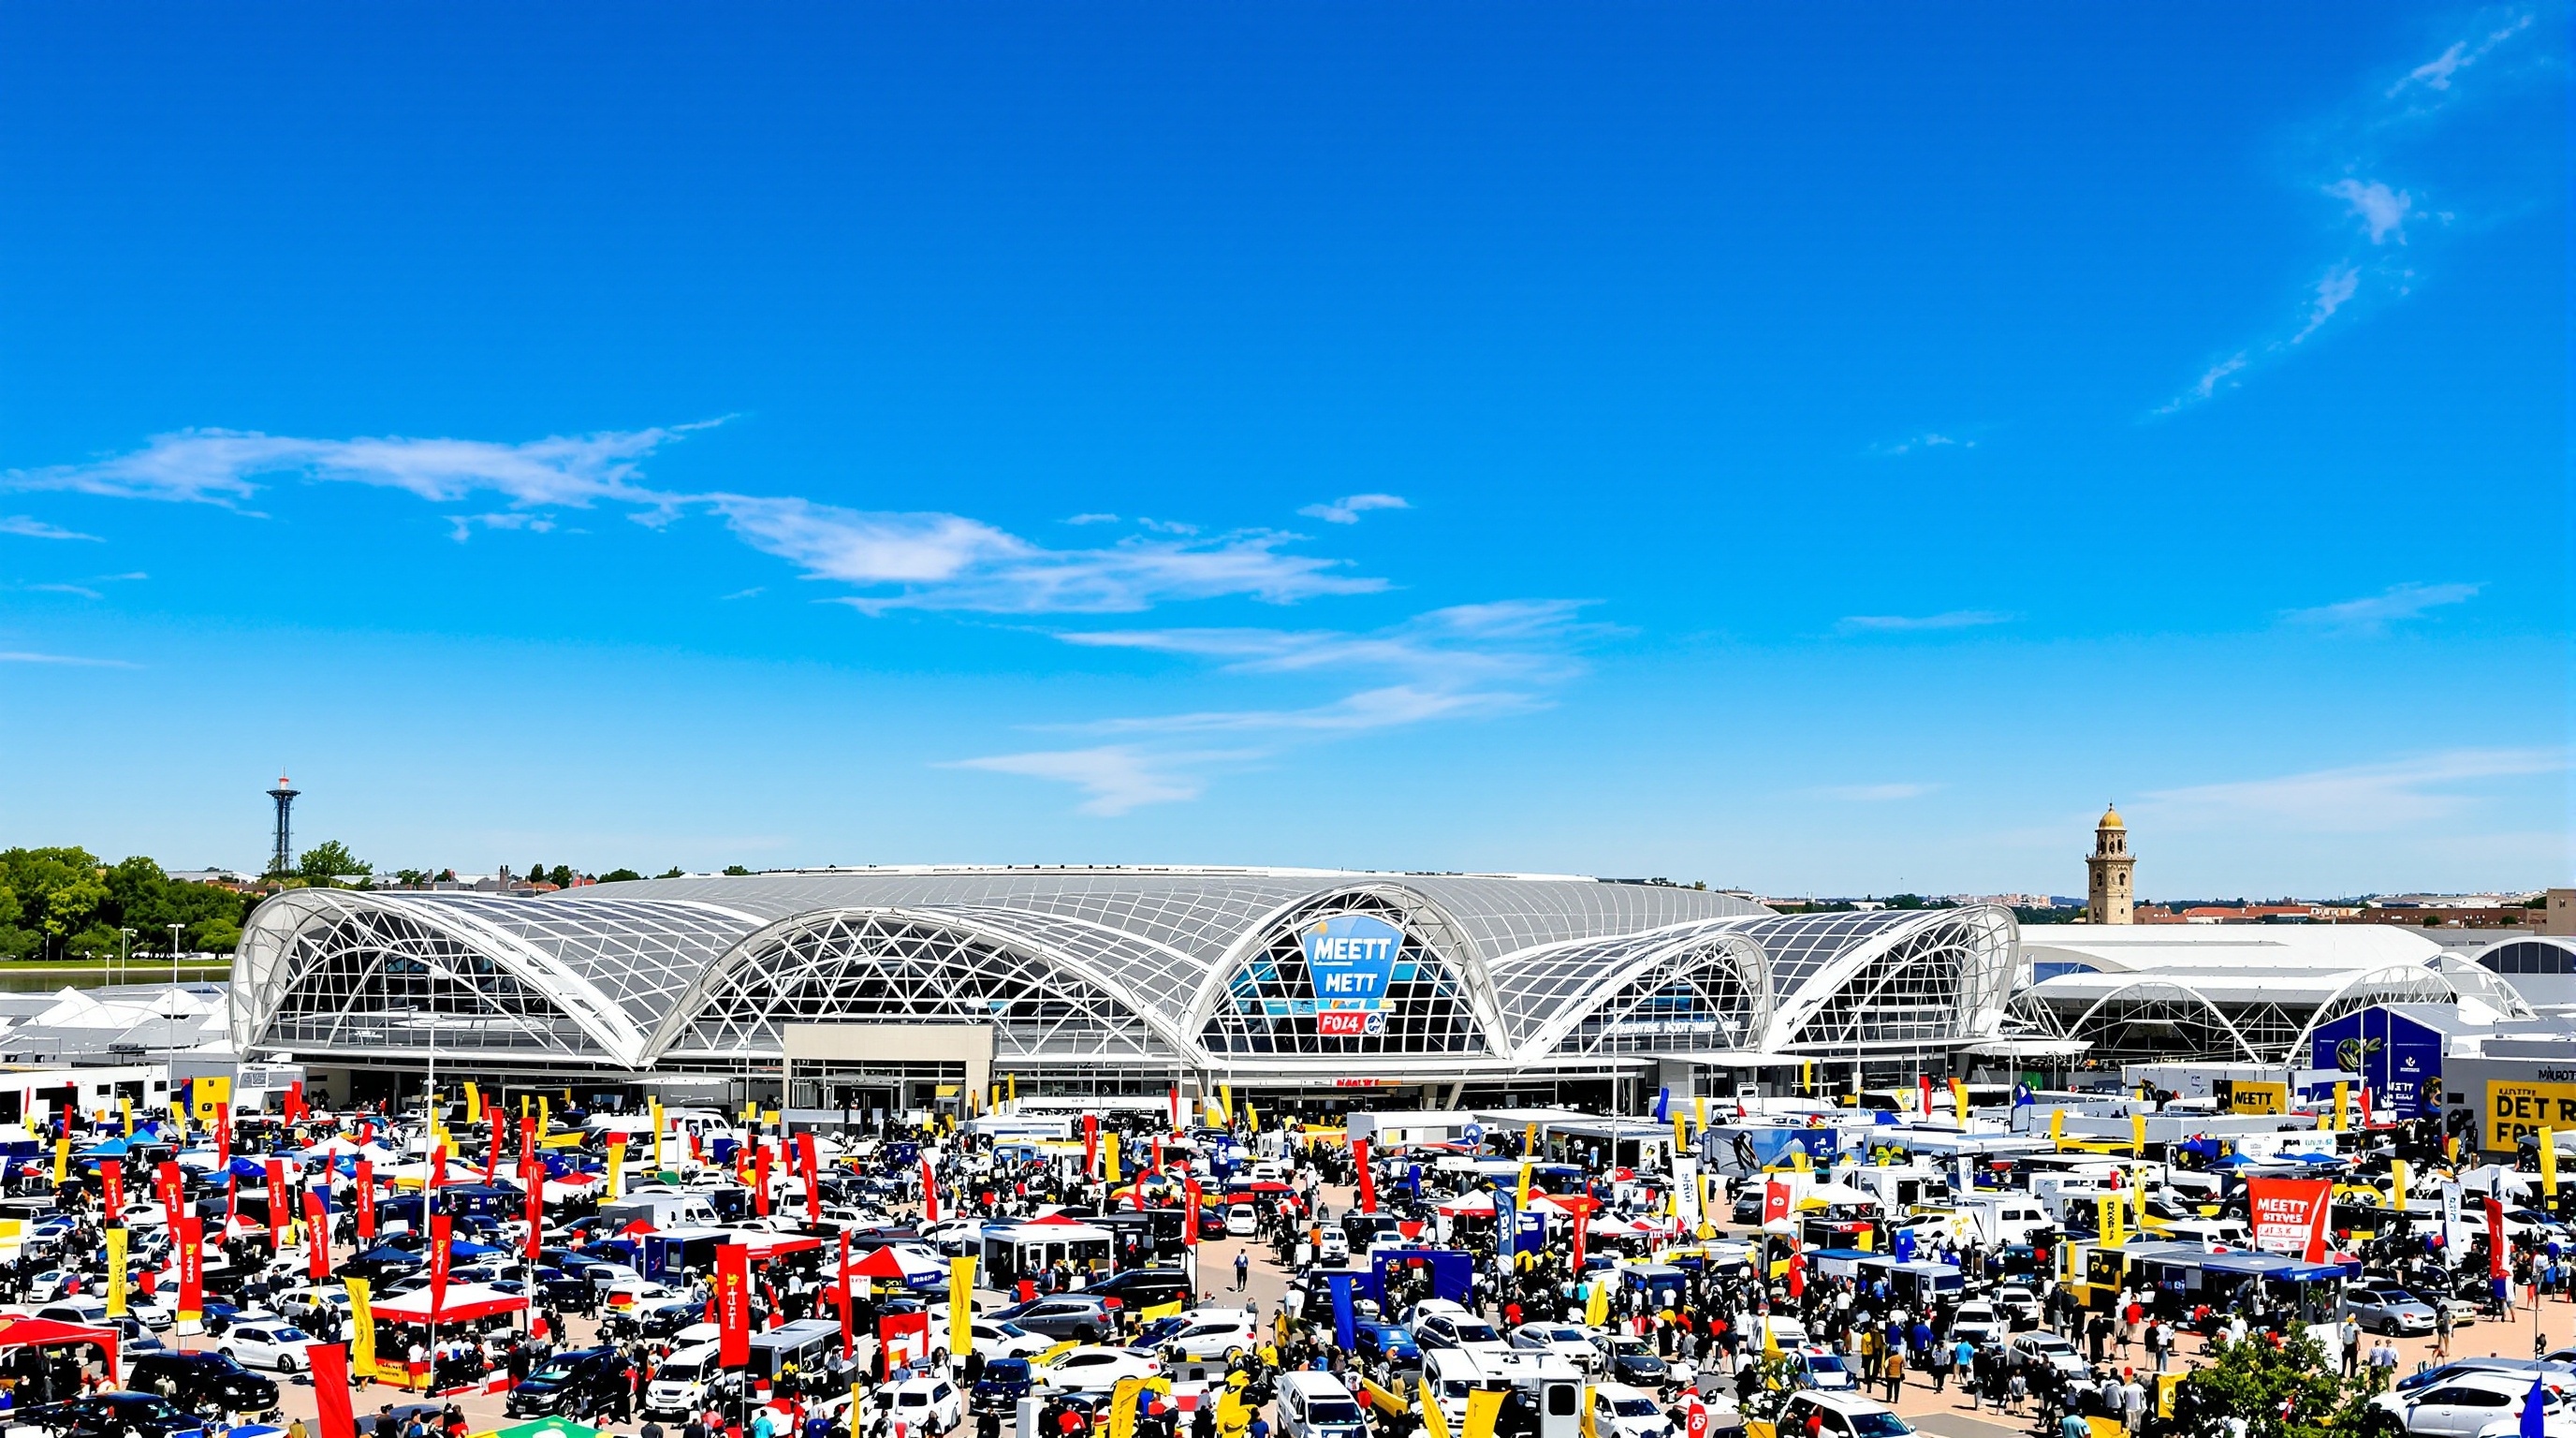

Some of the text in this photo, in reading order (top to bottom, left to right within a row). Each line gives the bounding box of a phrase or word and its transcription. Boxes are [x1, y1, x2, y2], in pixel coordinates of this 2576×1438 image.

[1313, 937, 1392, 961] MEETT
[1325, 974, 1378, 992] METT
[2496, 1095, 2550, 1119] DET
[2257, 1197, 2309, 1213] MEETT
